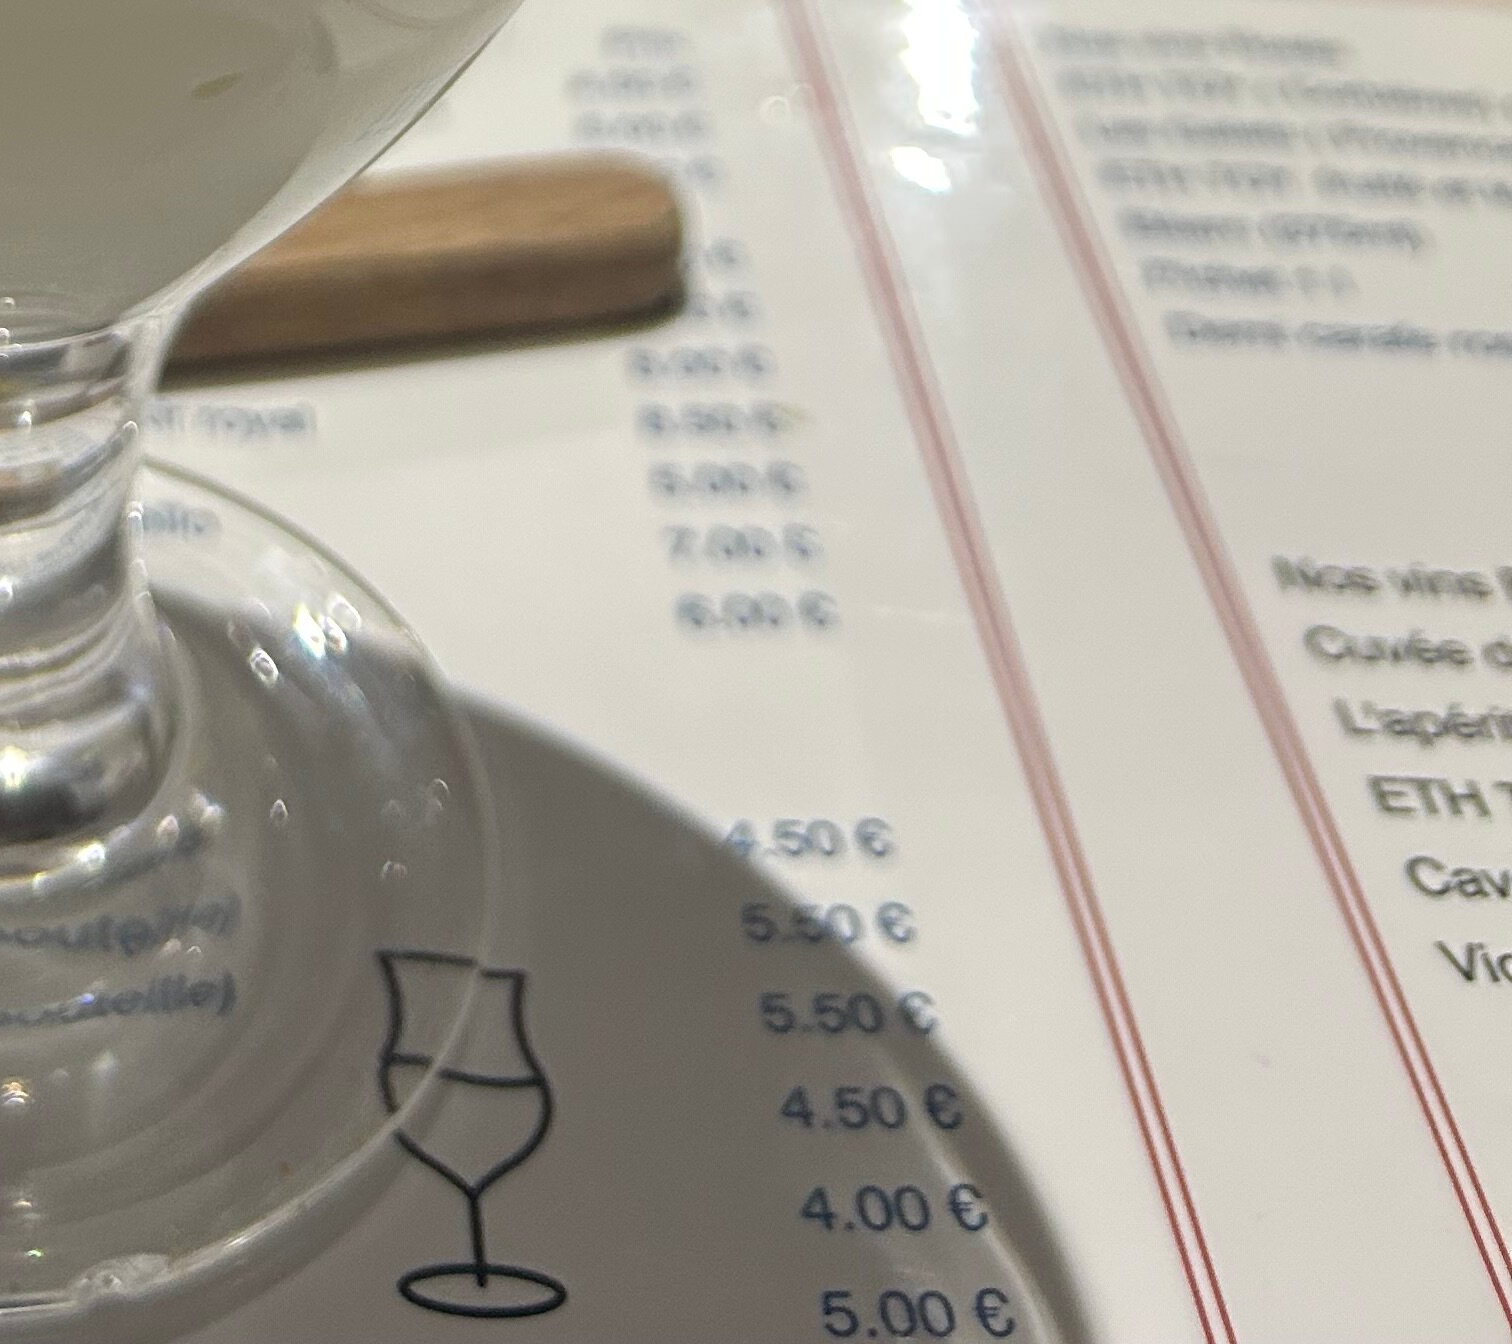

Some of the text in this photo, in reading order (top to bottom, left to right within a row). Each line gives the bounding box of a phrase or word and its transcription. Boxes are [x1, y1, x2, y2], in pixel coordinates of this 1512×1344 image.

[1302, 624, 1474, 666] Cuvée
[1367, 775, 1492, 819] ETH
[724, 817, 899, 859] 4.50 €
[740, 901, 917, 944] 5.50 €
[760, 990, 940, 1036] 5.50 €
[779, 1083, 964, 1130] 4.50 €
[801, 1183, 989, 1234] 4.00 €
[821, 1287, 1017, 1340] 5.00 €
